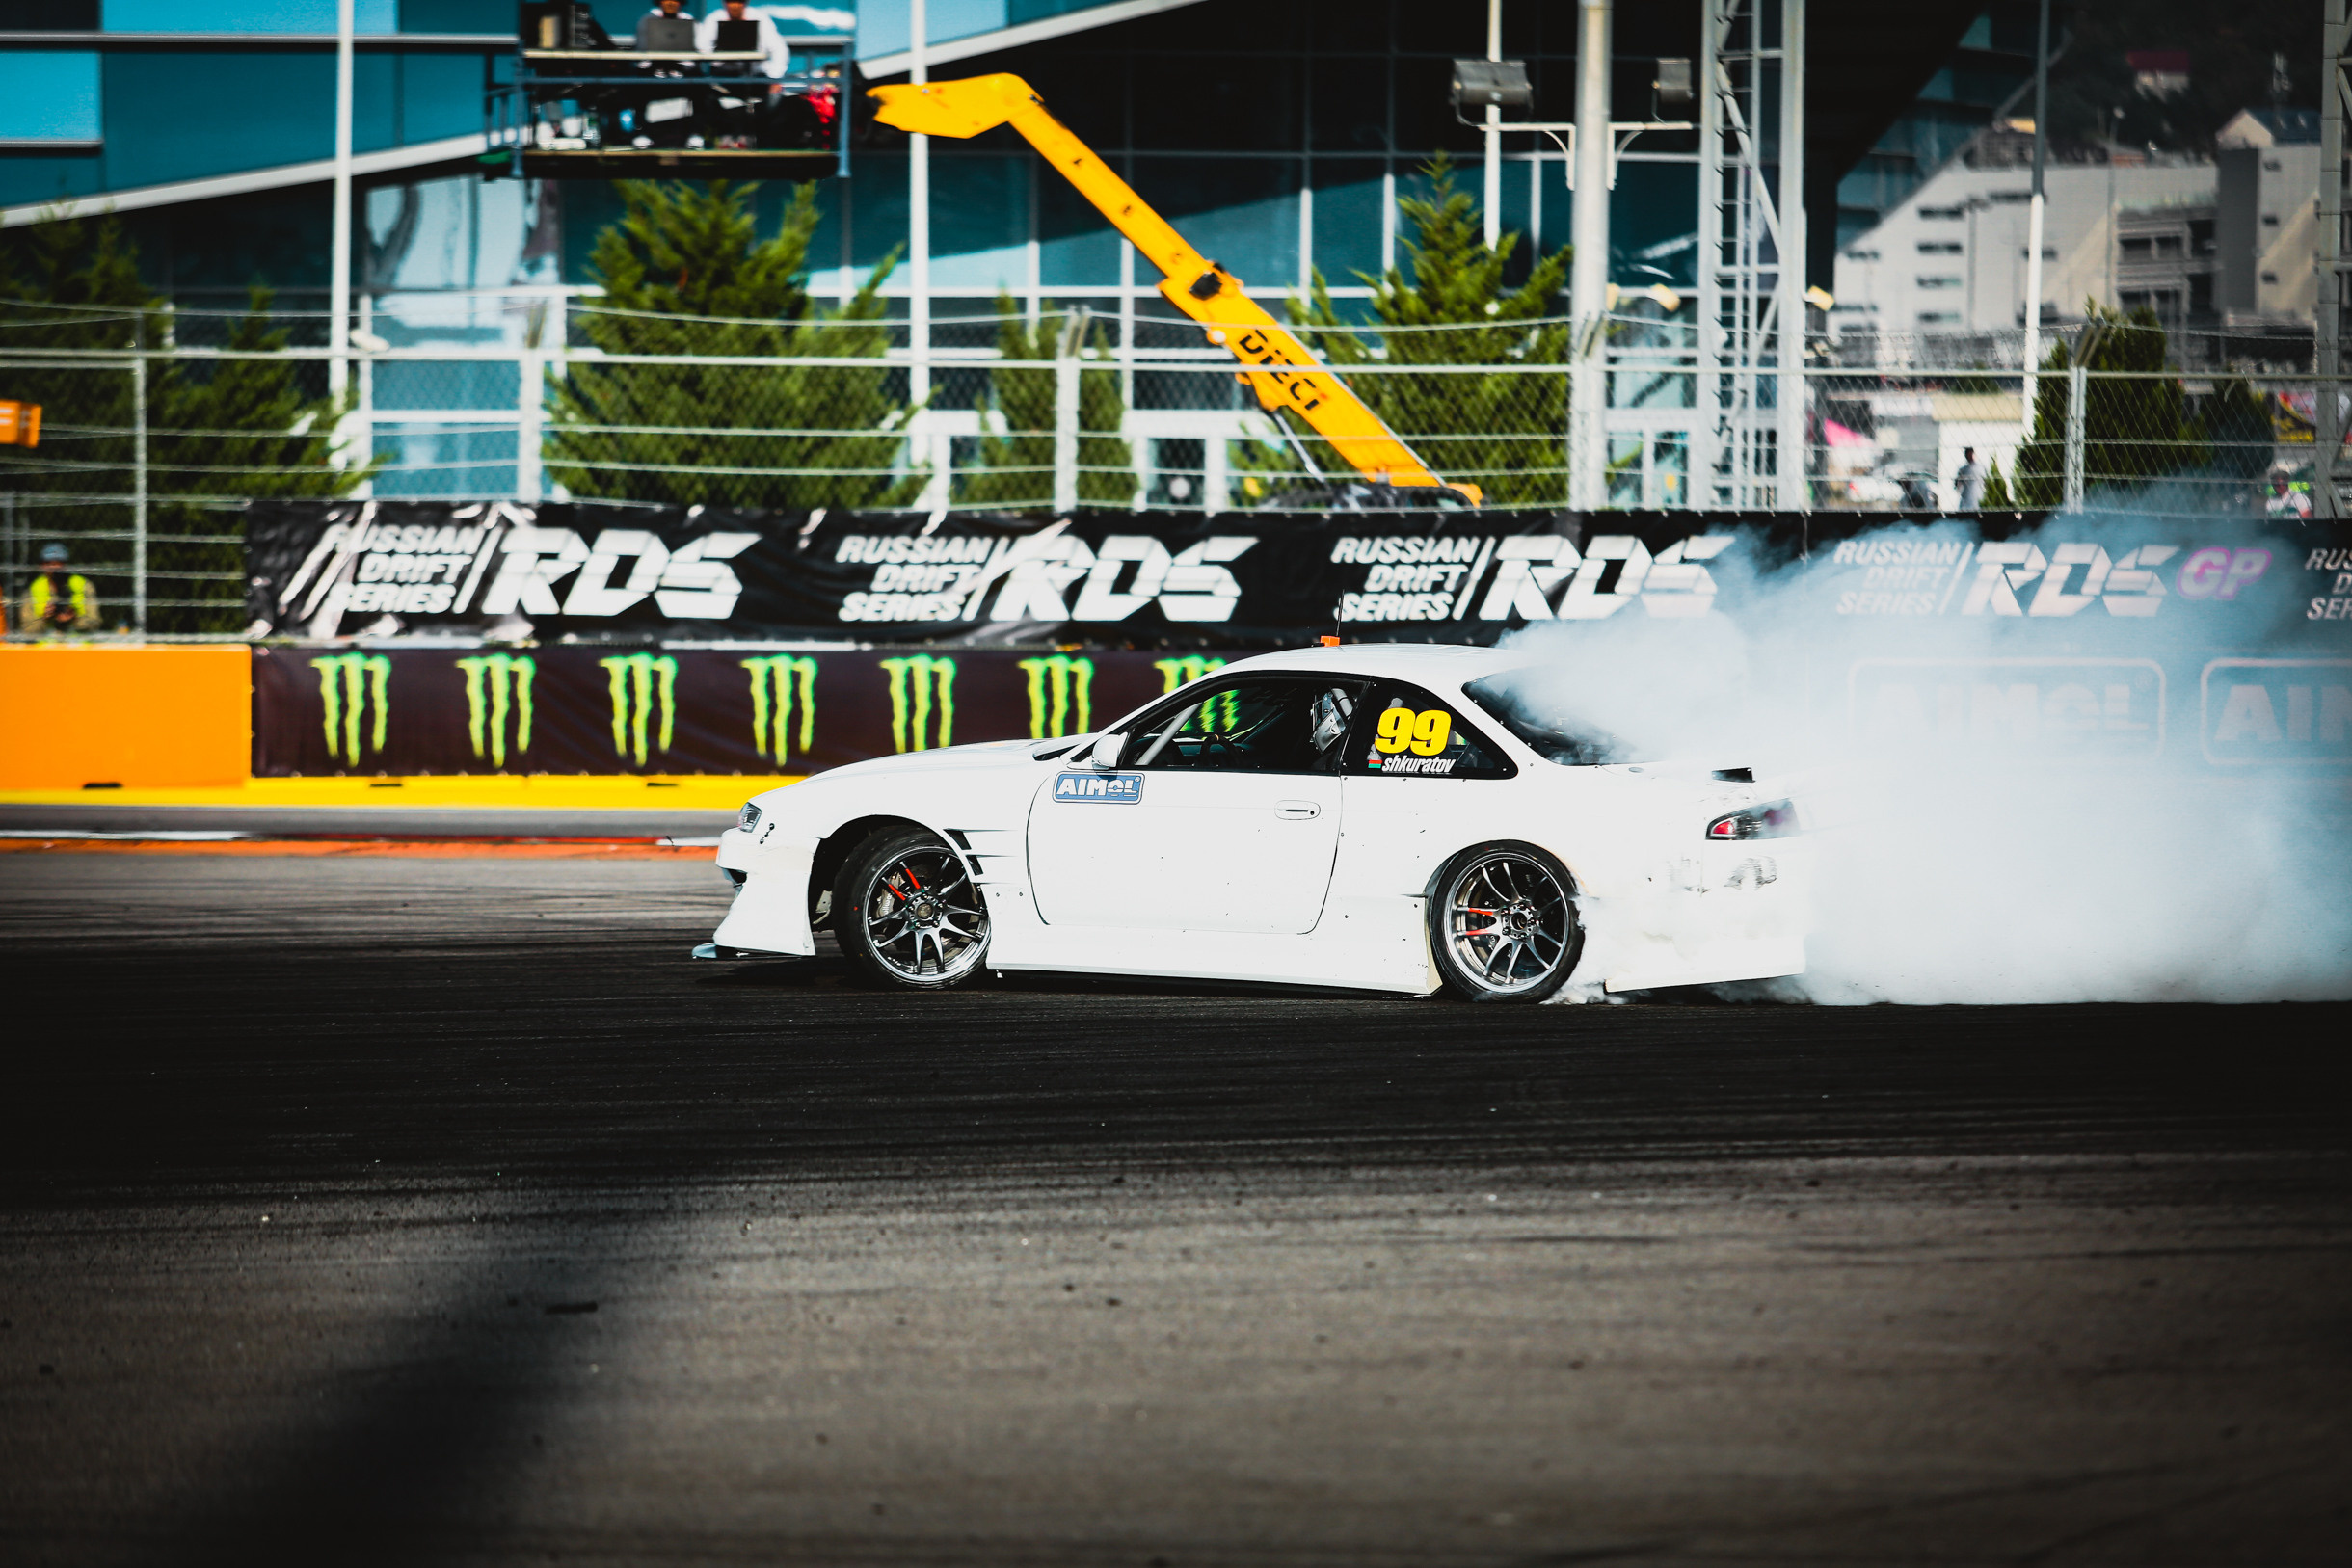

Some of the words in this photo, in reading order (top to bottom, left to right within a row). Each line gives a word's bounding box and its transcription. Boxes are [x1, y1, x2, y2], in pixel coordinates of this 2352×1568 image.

[333, 523, 485, 554] RUSSIAN
[835, 535, 994, 564] RUSSIAN
[1330, 535, 1480, 564] RUSSIAN
[1832, 540, 1962, 565] RUSSIAN
[358, 552, 473, 583] DRIFT
[483, 526, 762, 619] RDS
[870, 563, 983, 593] DRIFT
[990, 534, 1259, 622] RDS
[1363, 564, 1468, 593] DRIFT
[1479, 534, 1736, 621] RDS
[1865, 565, 1950, 591] DRIFT
[1962, 541, 2180, 618] RDS
[2177, 546, 2272, 600] GP
[331, 581, 457, 614] SERIES
[838, 592, 966, 622] SERIES
[1333, 593, 1455, 622] SERIES
[1835, 592, 1939, 616] SERIES
[1374, 707, 1452, 757] 99
[1381, 754, 1457, 774] shkuratov
[1056, 778, 1138, 797] AIMOL
